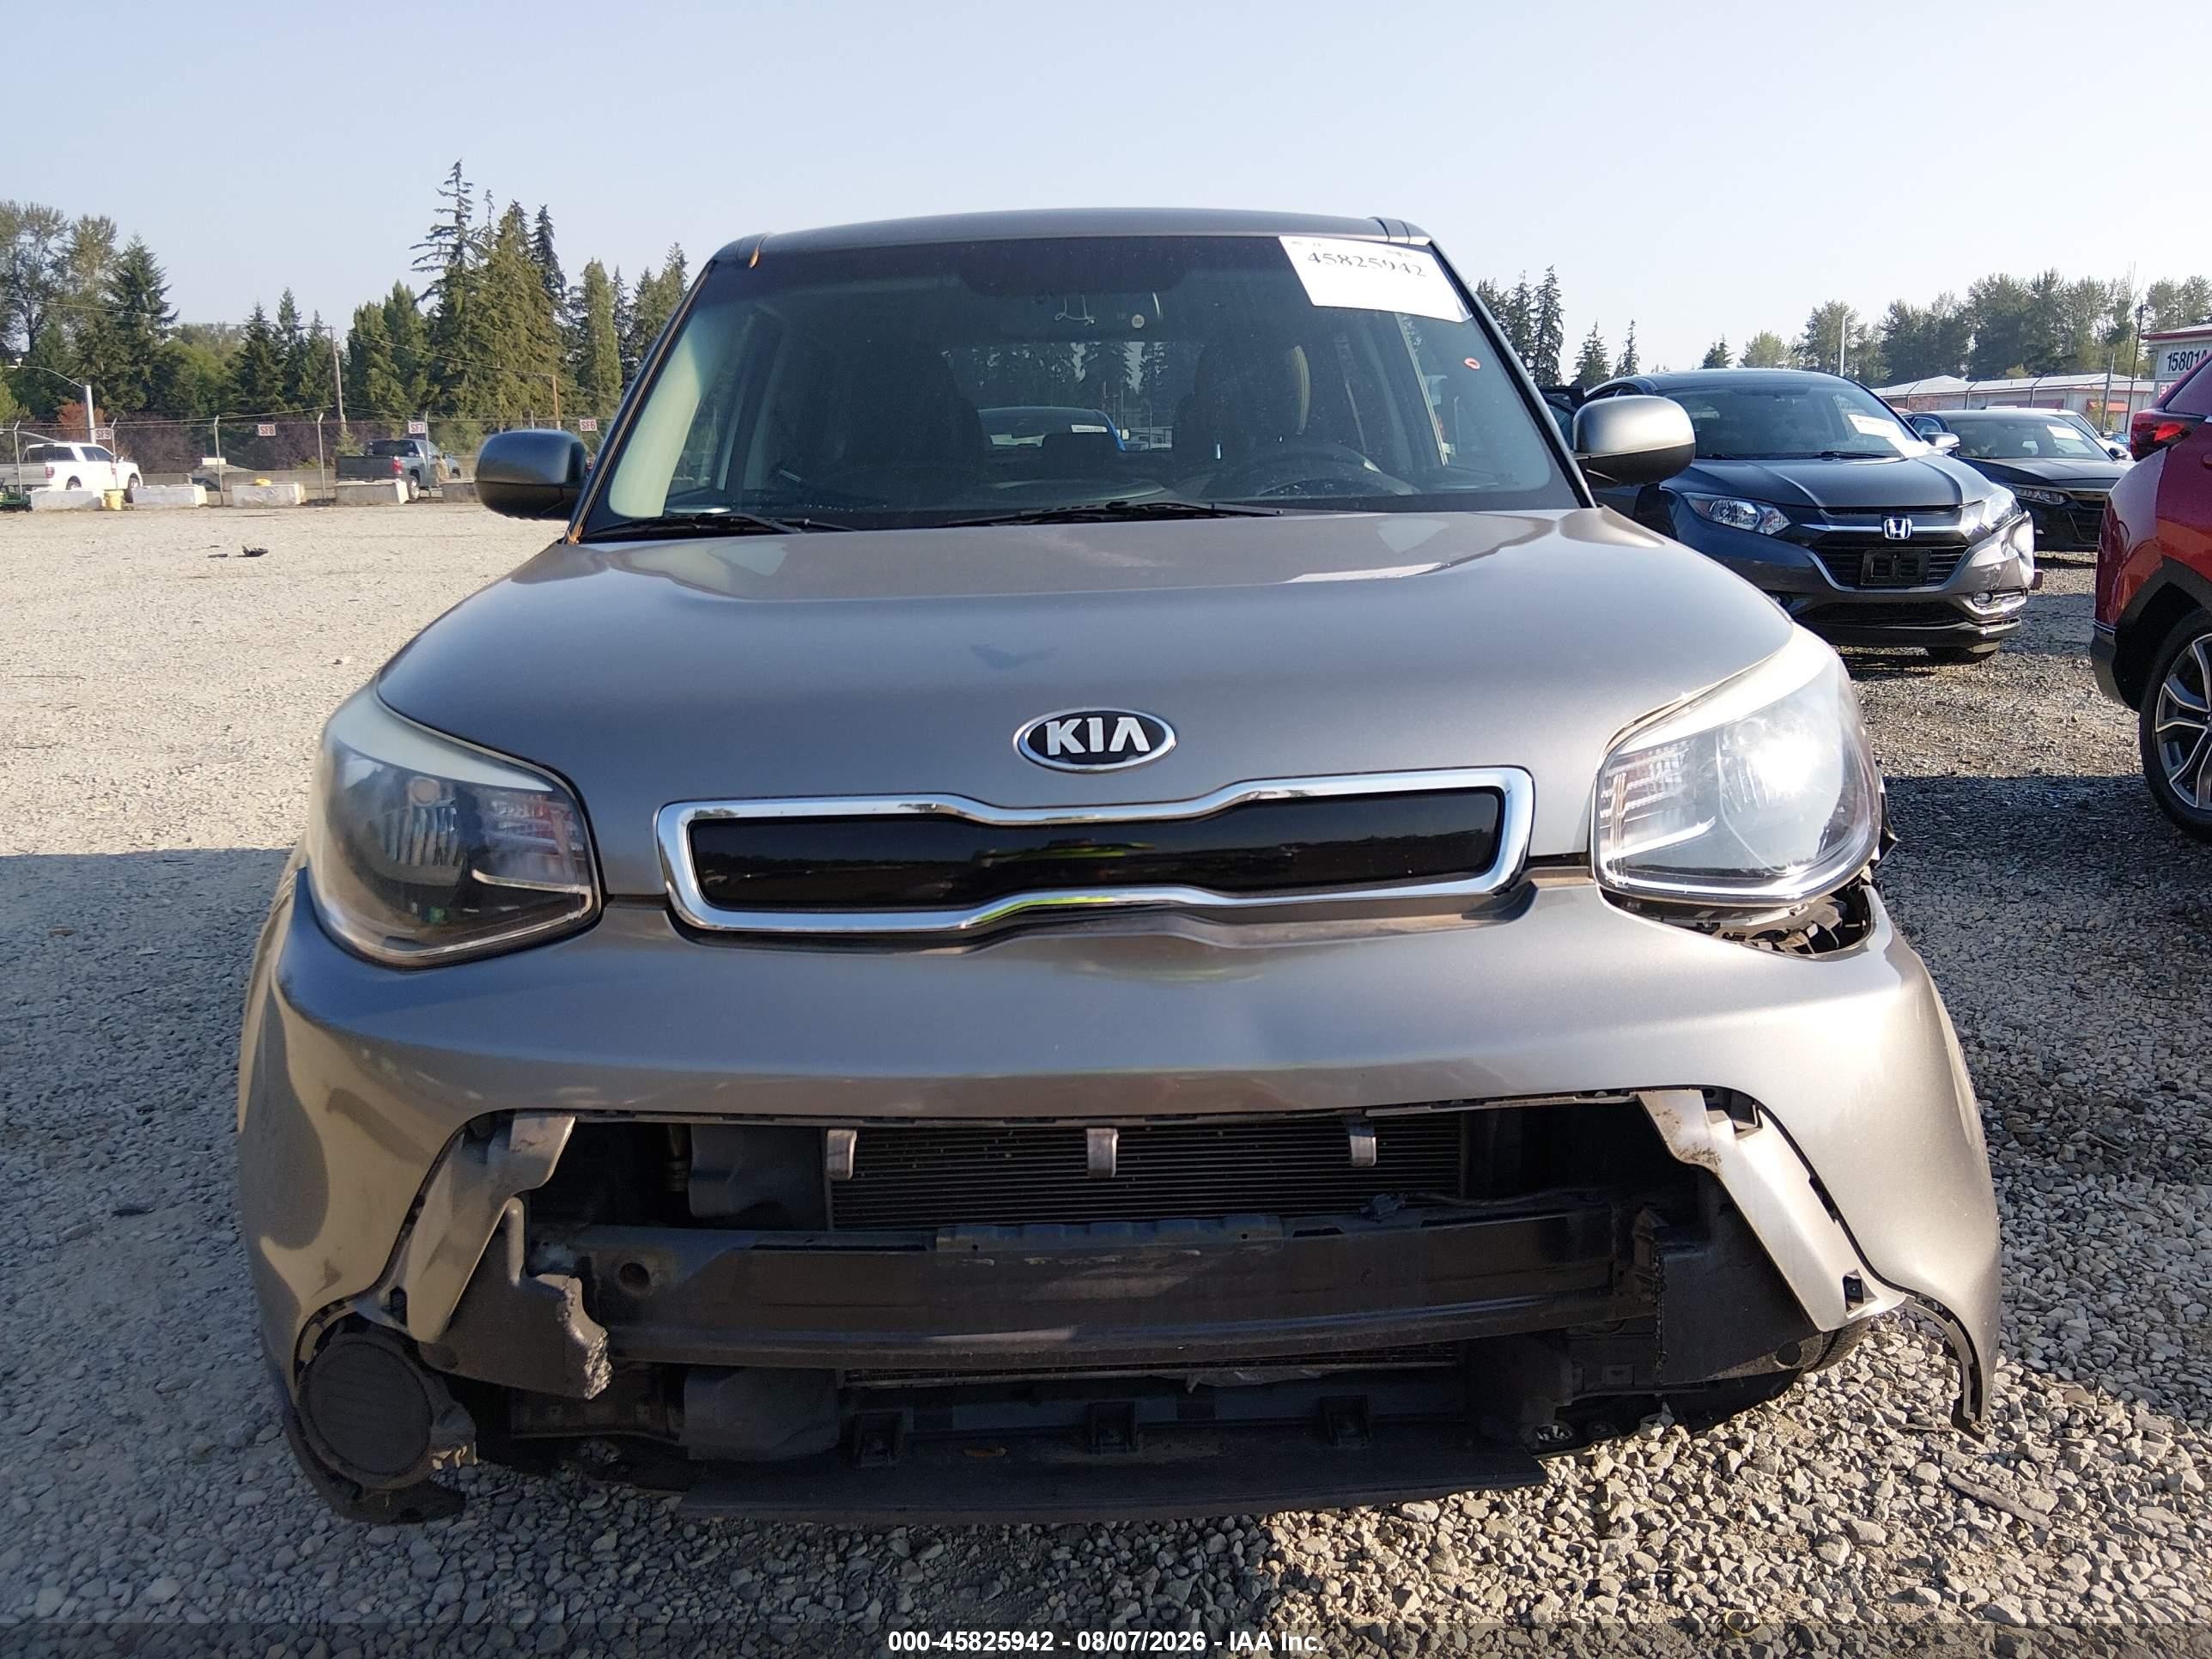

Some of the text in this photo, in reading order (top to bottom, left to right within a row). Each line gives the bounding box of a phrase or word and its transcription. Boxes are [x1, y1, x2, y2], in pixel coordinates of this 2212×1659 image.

[1307, 252, 1427, 277] 45825942
[410, 422, 423, 433] SF7
[581, 421, 596, 430] SF6
[95, 429, 110, 439] SF9
[1045, 716, 1151, 756] KIA
